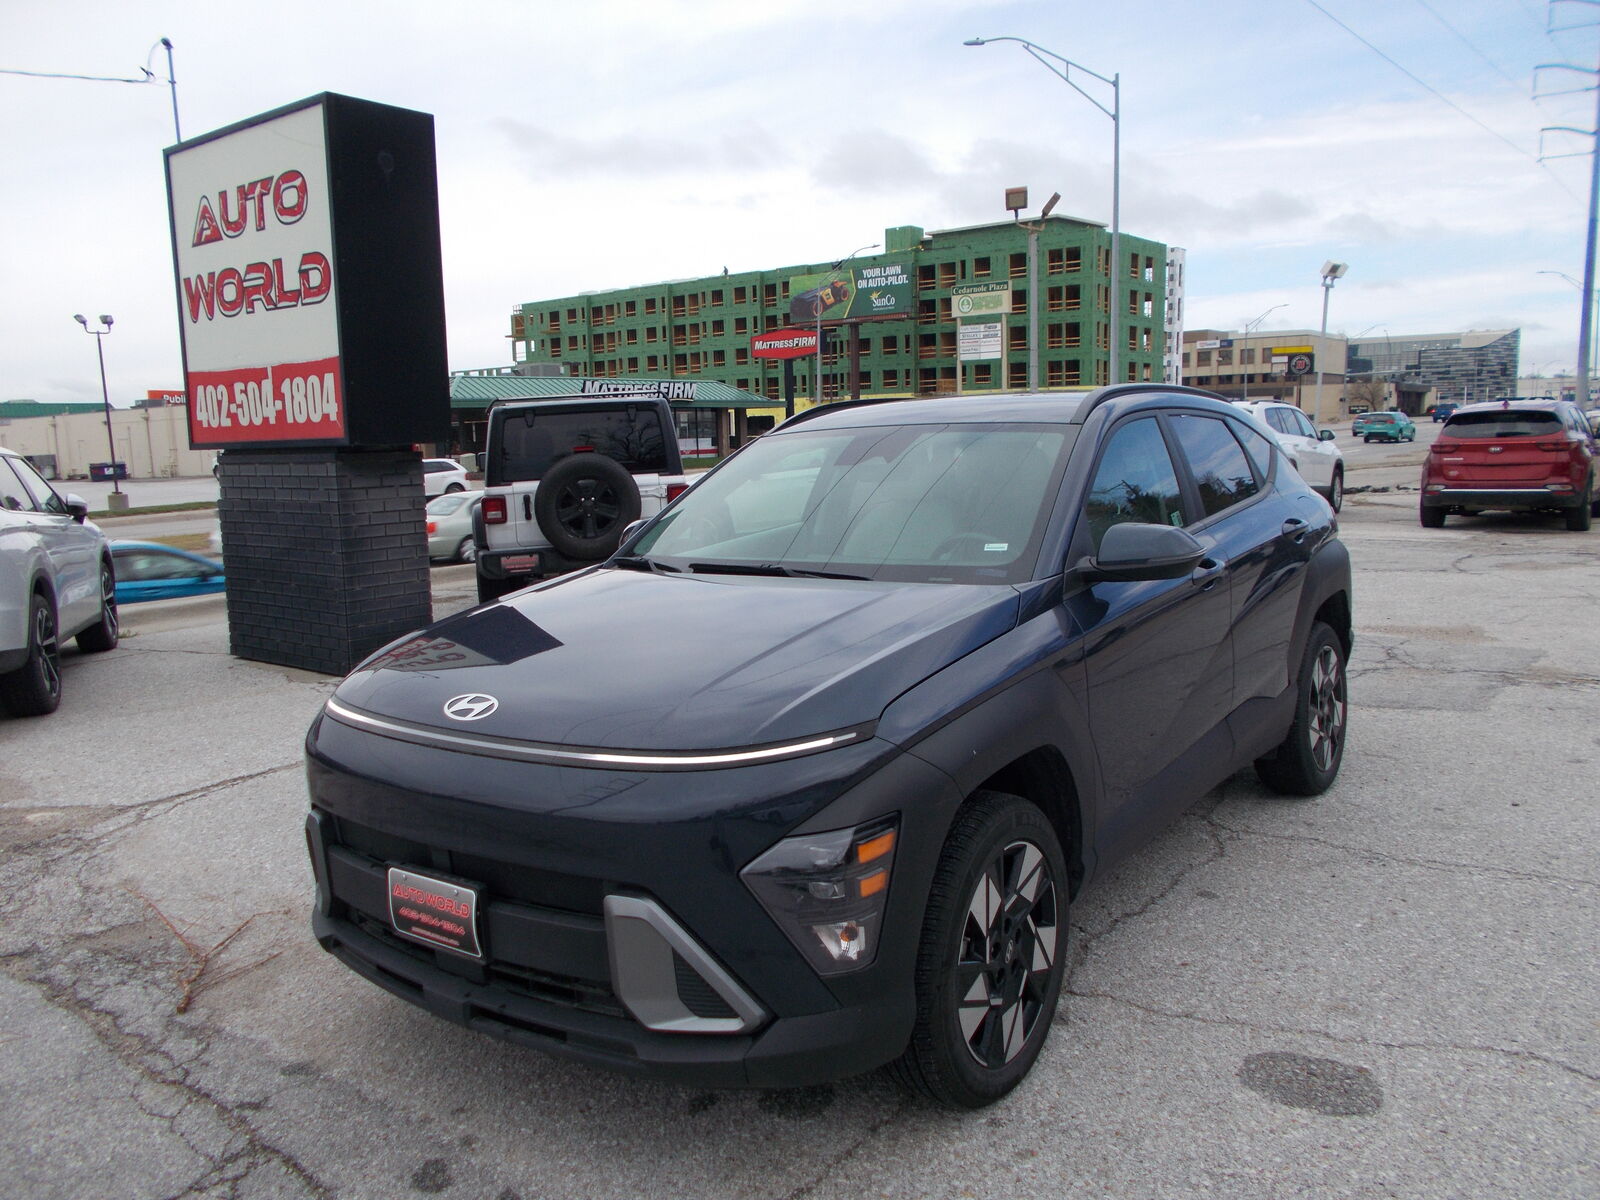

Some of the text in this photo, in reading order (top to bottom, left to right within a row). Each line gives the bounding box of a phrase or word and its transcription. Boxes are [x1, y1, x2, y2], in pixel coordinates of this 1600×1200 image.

[192, 169, 308, 248] AUTO
[862, 265, 901, 278] YOUR LAWN
[183, 251, 331, 323] WORLD
[857, 279, 868, 289] ON
[989, 283, 1007, 291] Plaza
[872, 294, 895, 307] SunCo
[195, 372, 338, 428] 402-504-1804
[393, 883, 470, 918] AUTO WORLD
